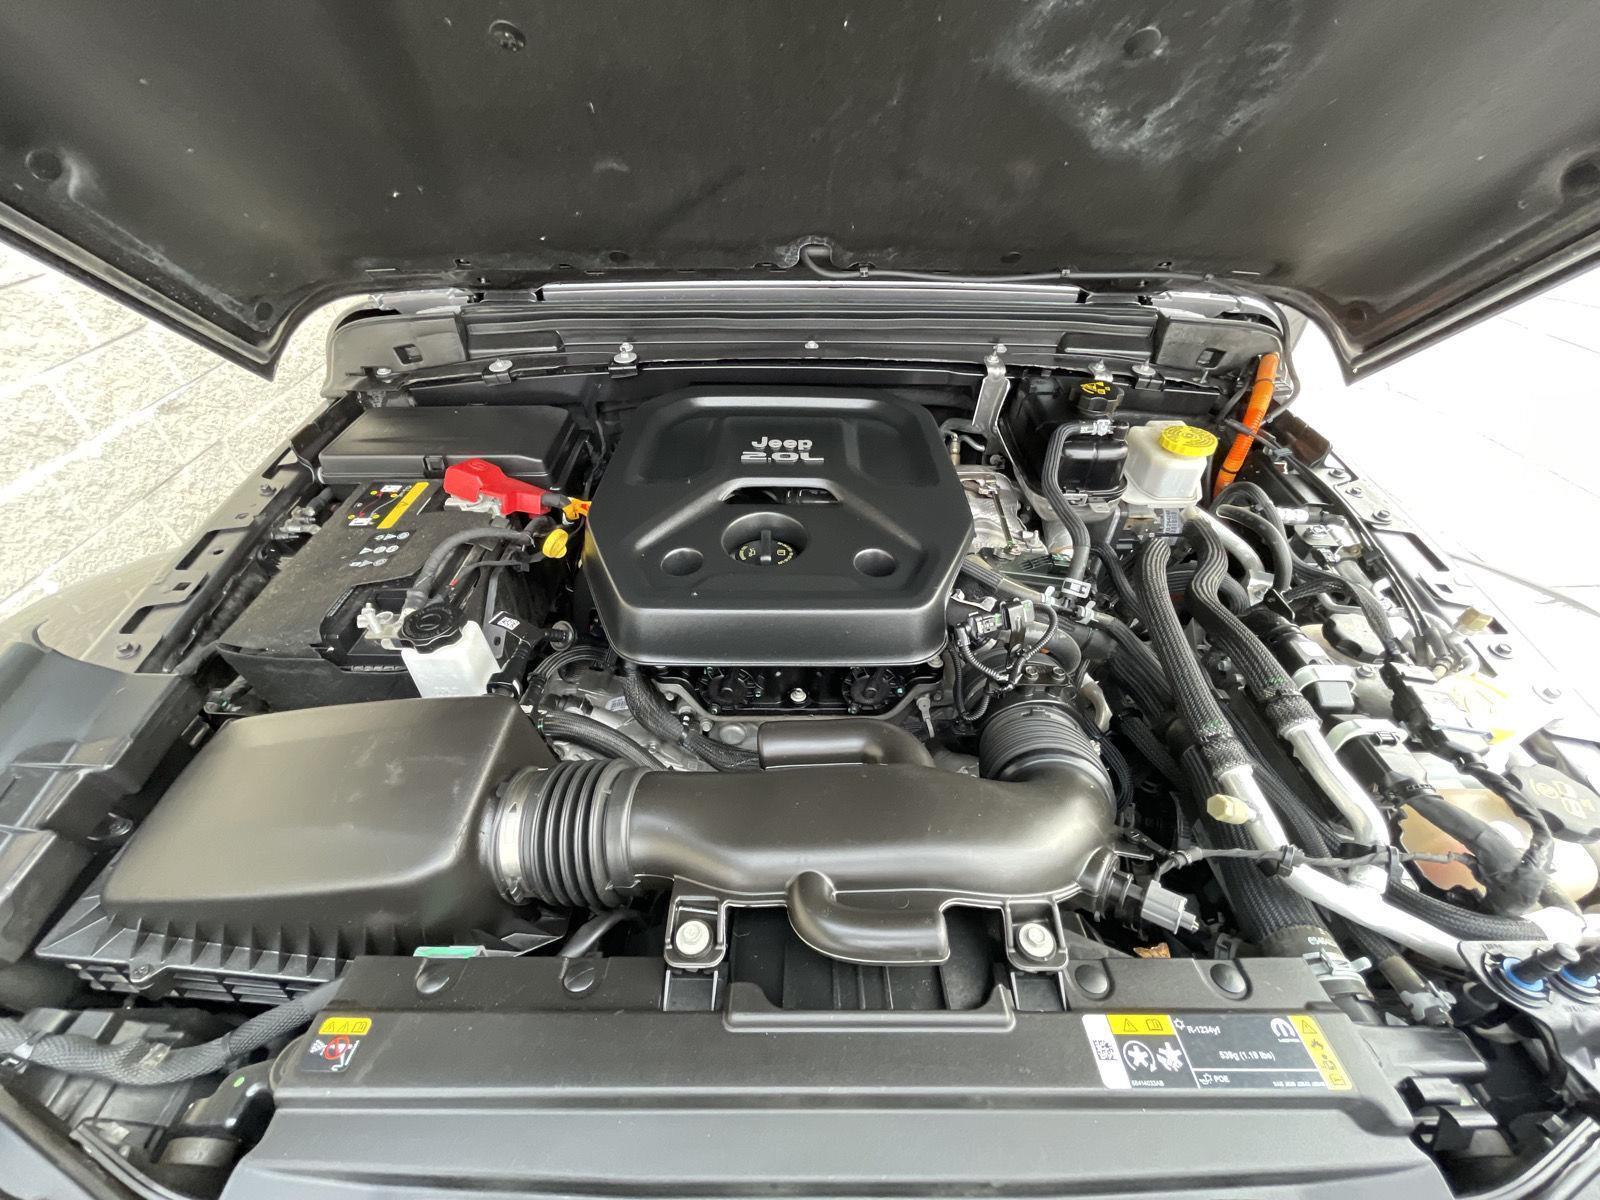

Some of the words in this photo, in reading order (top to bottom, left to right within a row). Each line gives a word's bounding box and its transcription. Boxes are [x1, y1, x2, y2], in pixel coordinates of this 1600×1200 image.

[751, 436, 813, 450] Jeep
[740, 451, 825, 464] 2.0L
[1213, 1075, 1231, 1083] POE
